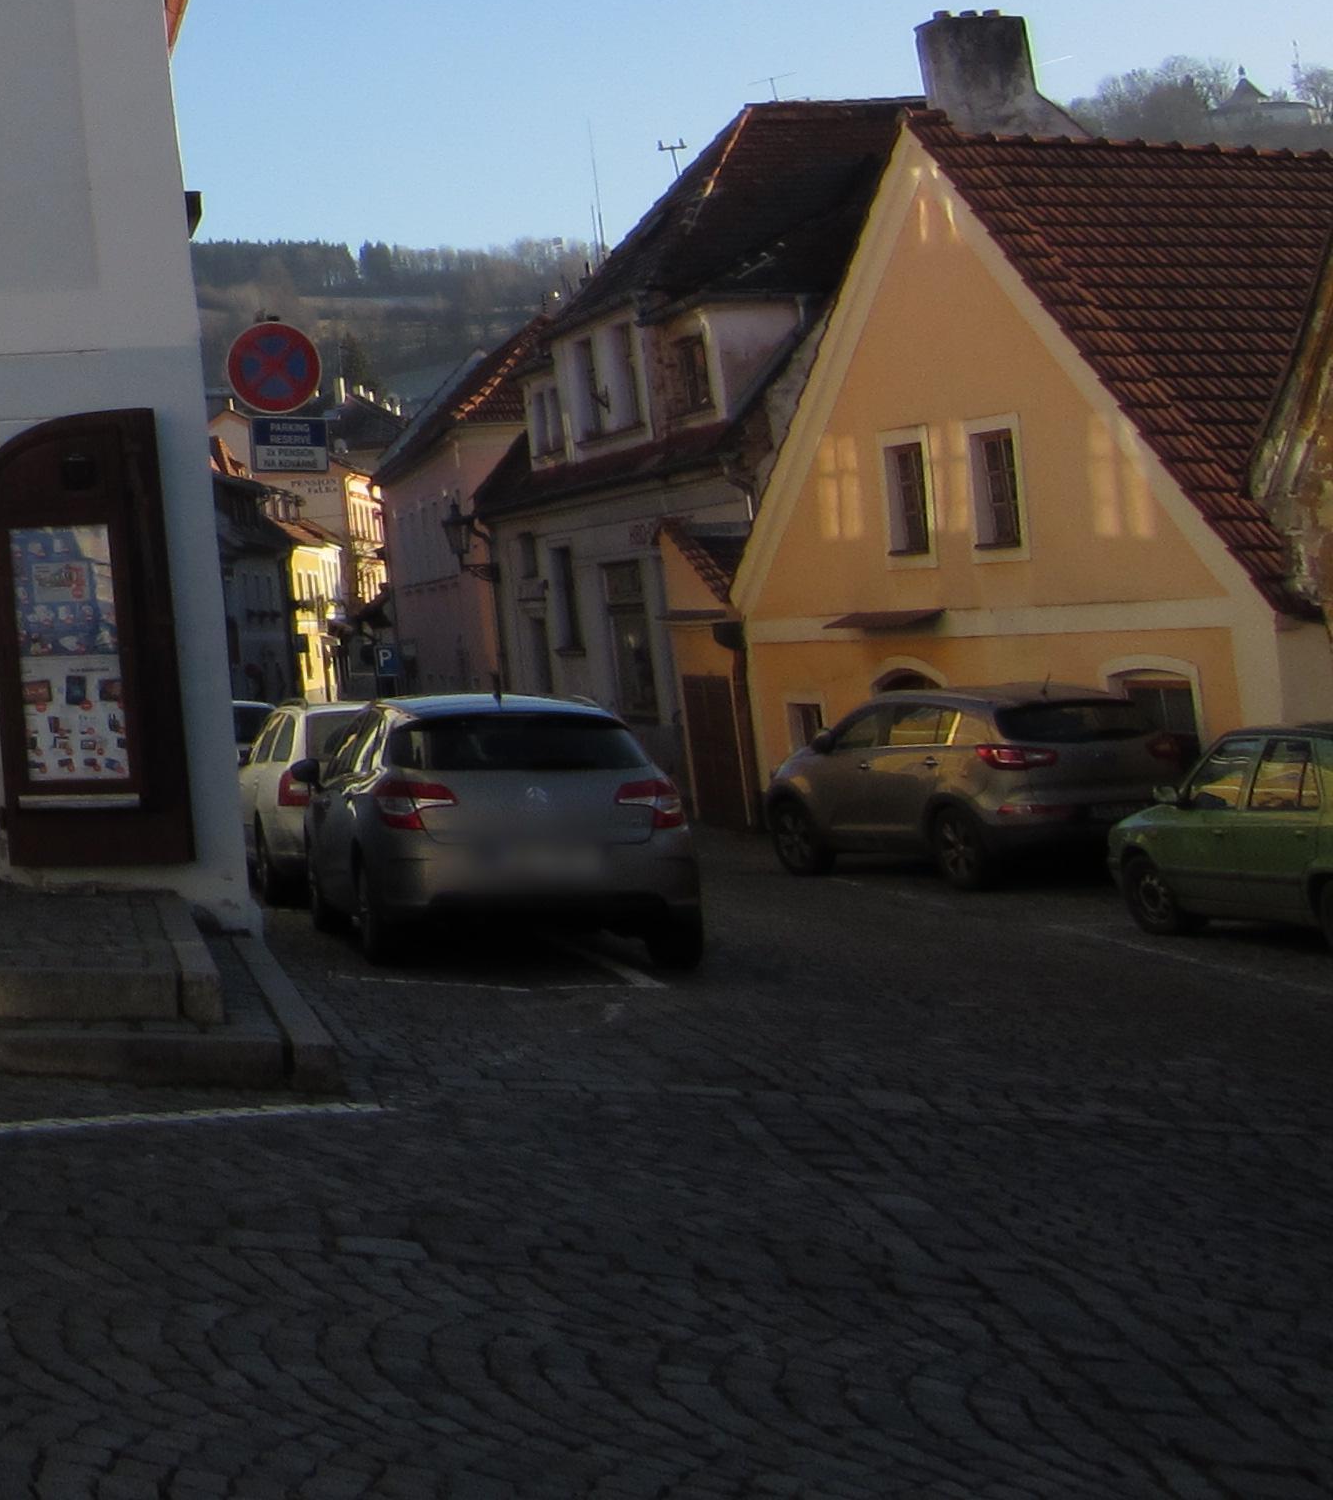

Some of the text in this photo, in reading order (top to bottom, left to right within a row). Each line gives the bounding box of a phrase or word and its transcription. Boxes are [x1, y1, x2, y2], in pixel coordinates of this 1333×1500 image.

[269, 422, 310, 433] PARKING
[278, 448, 315, 457] PENSION
[263, 459, 276, 468] NA
[379, 649, 393, 668] P
